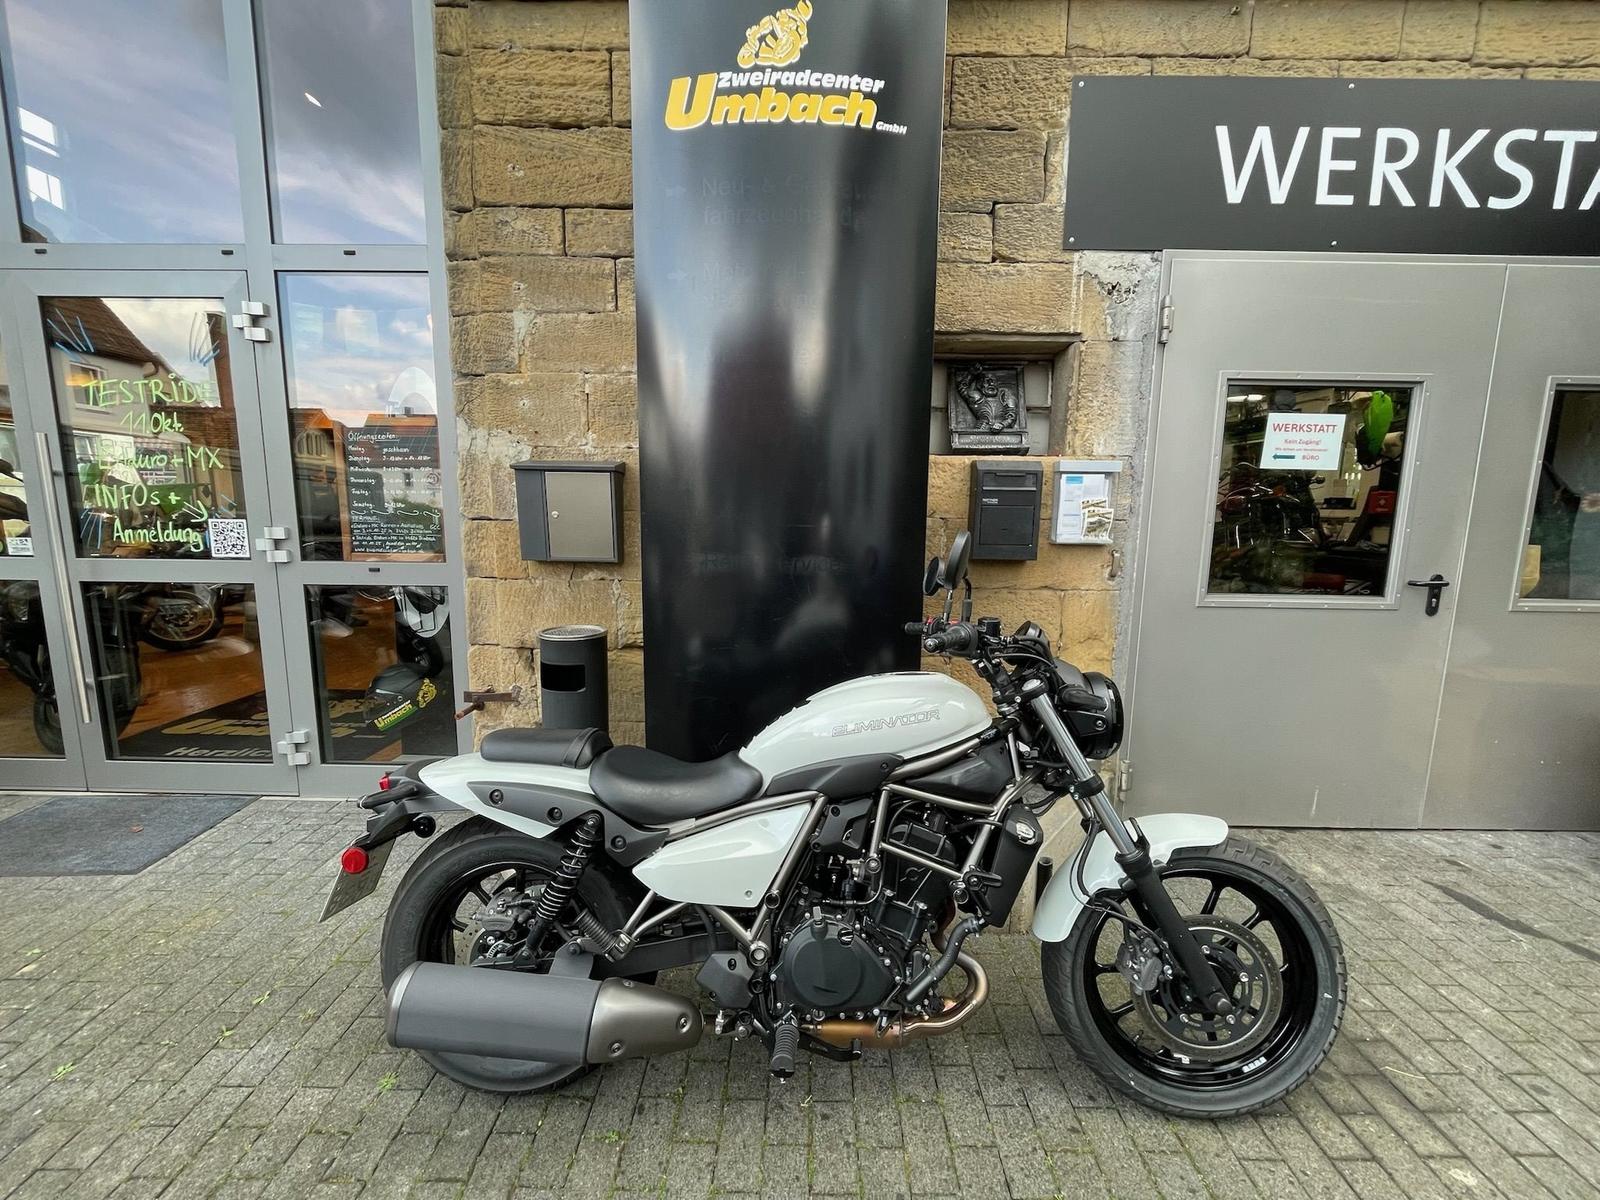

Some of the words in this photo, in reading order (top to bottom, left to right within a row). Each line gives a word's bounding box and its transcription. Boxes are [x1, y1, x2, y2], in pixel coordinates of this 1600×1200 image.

[717, 68, 885, 93] Zweiradcenter
[664, 72, 878, 131] Umbach
[875, 121, 908, 135] GmbH
[1272, 423, 1337, 433] WERKSTATT
[98, 441, 168, 469] Eduro
[187, 446, 224, 471] MX
[95, 483, 160, 510] INFOs
[113, 518, 203, 552] Anmeldung
[831, 708, 941, 737] ELIMINATOR
[164, 747, 273, 757] Herzlic
